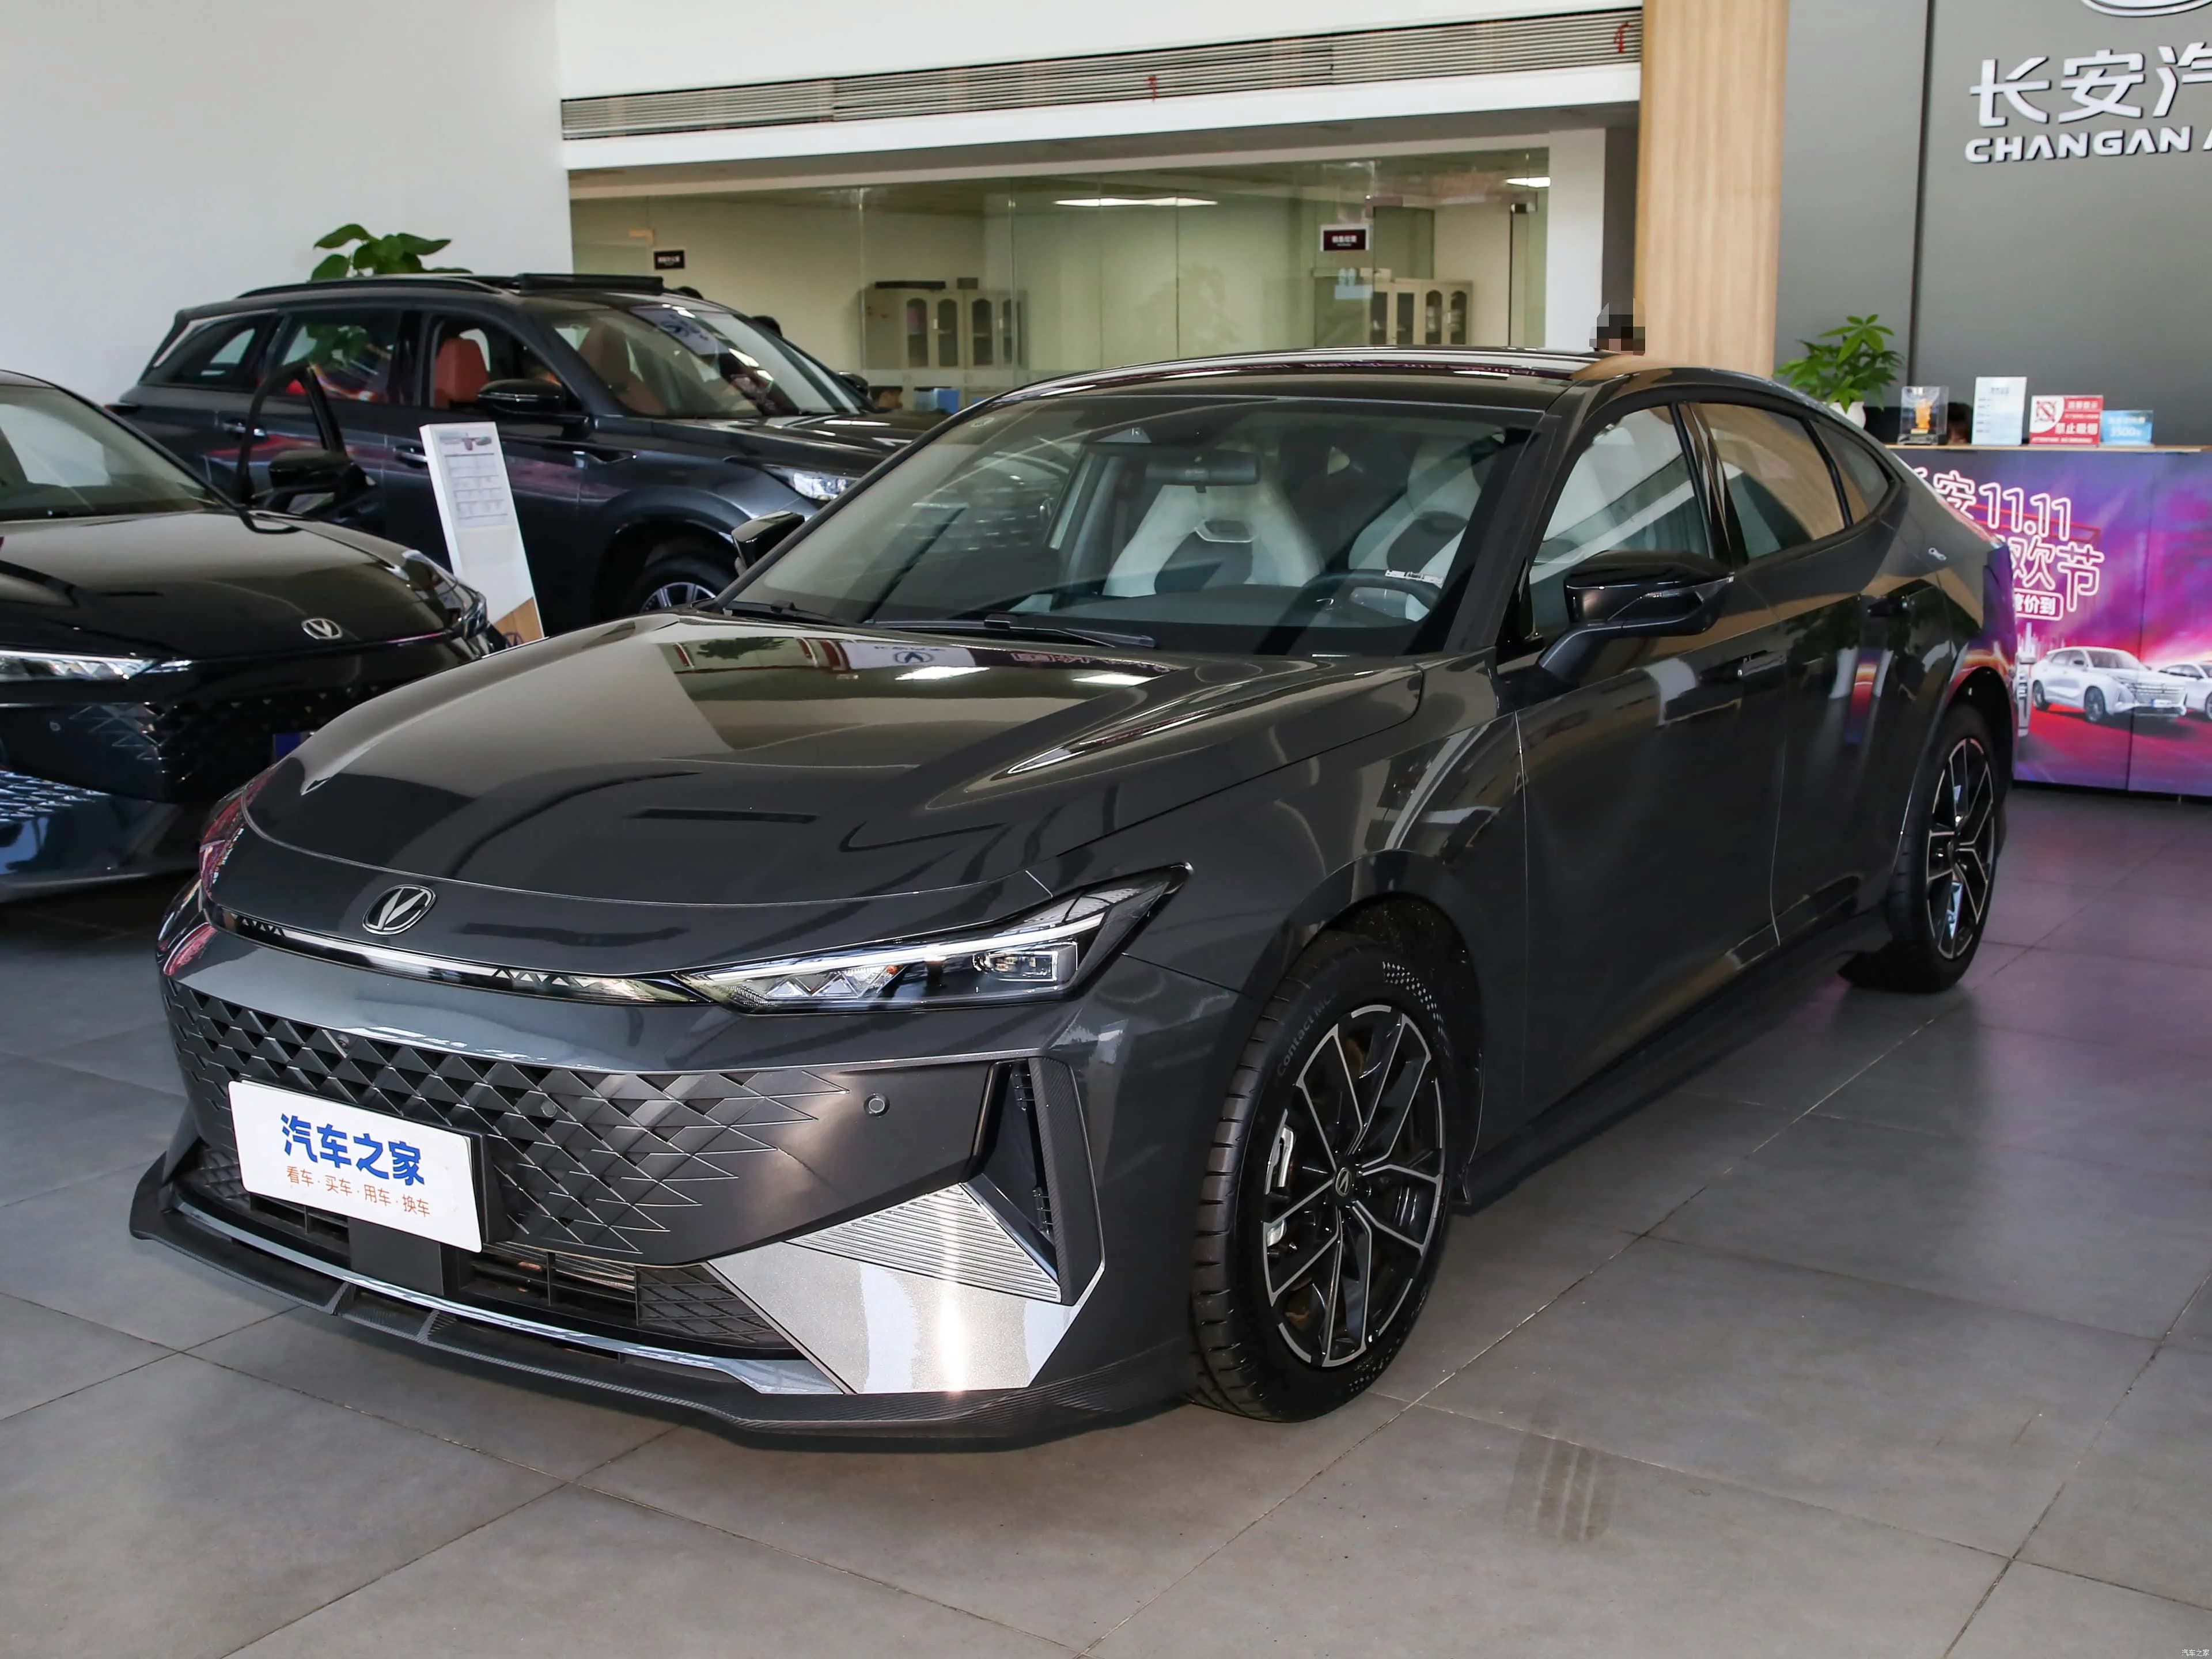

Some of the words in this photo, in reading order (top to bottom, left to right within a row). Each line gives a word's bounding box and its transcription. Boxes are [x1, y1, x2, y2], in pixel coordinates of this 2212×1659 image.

[1965, 126, 2192, 164] CHANGAN
[1914, 467, 2071, 541] 安11.11
[1997, 534, 2105, 612] 欢节
[1277, 1014, 1315, 1077] Contact
[281, 1112, 425, 1186] 汽车之家
